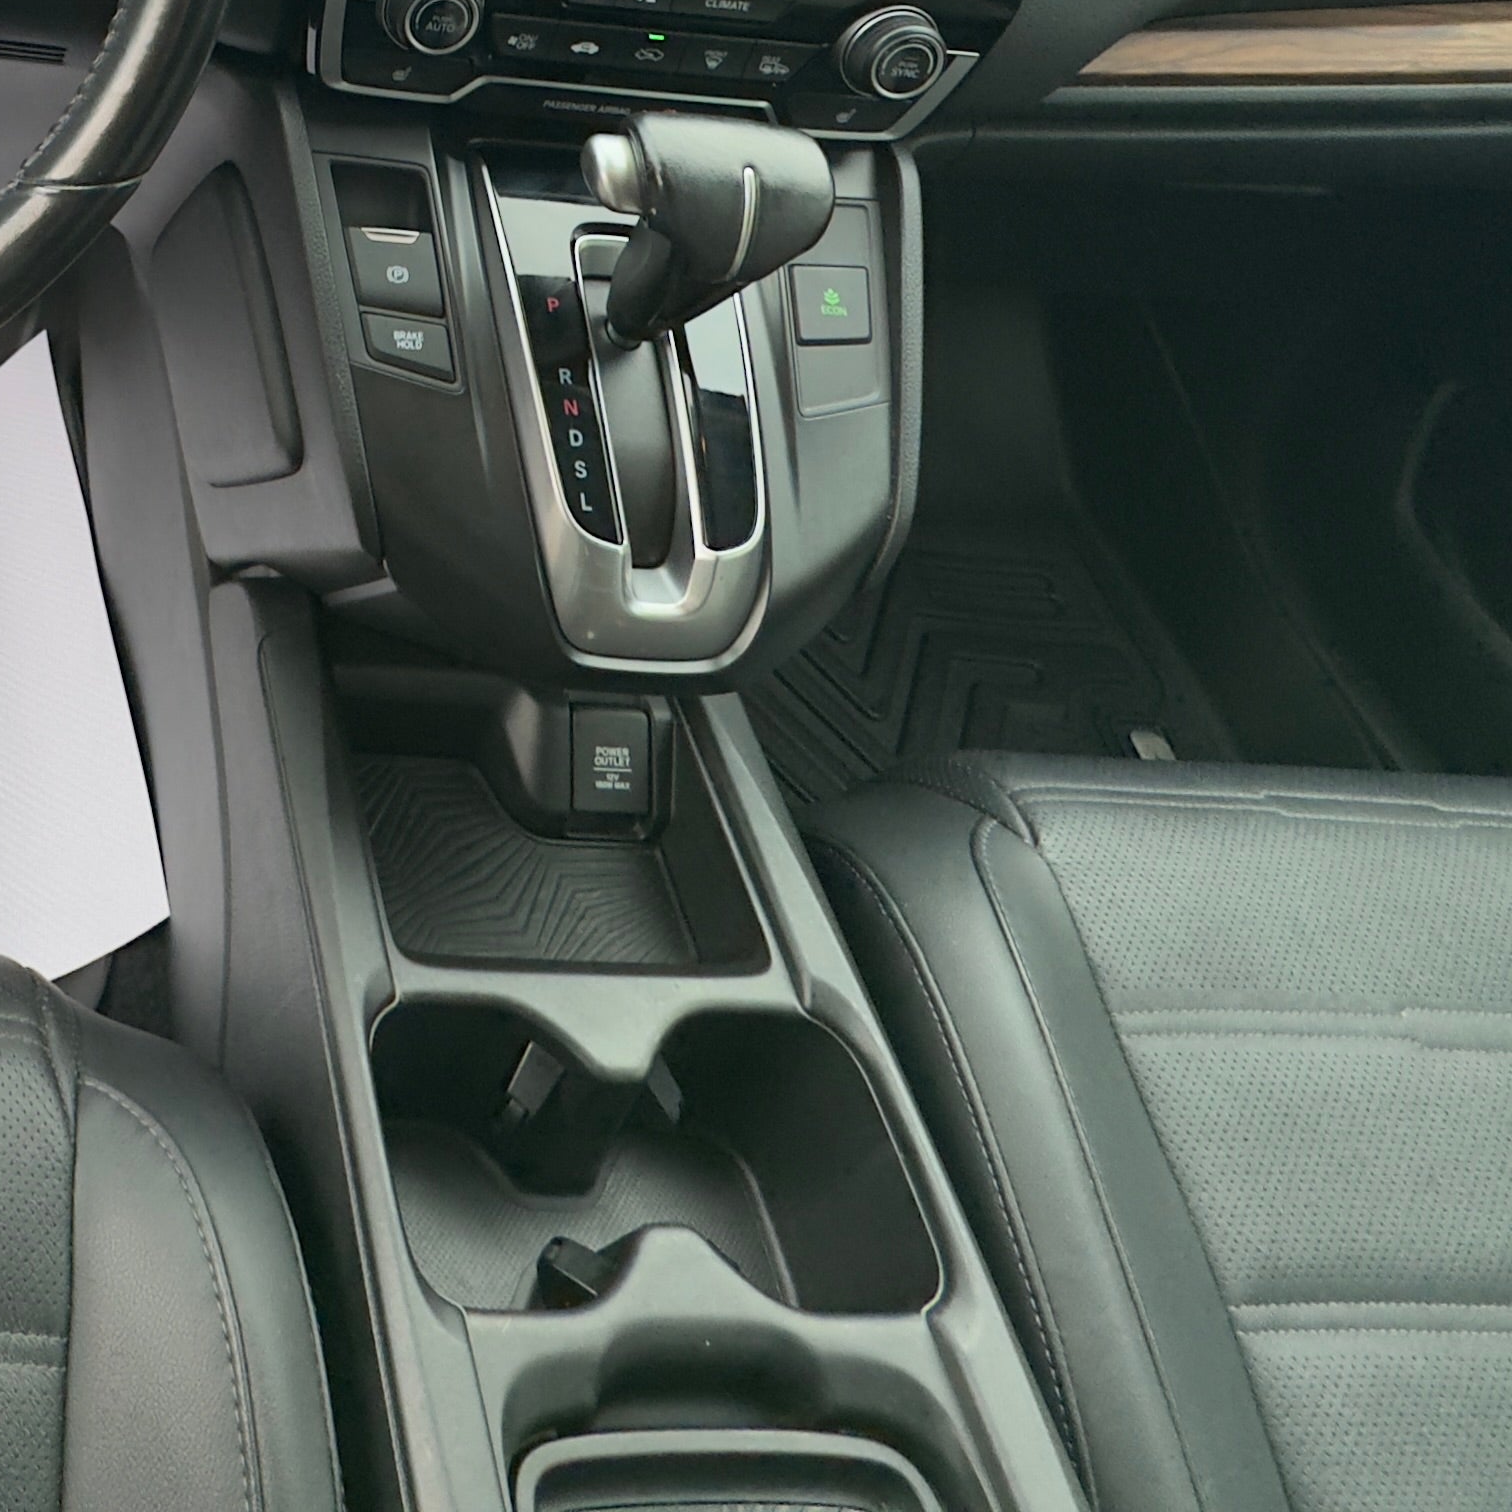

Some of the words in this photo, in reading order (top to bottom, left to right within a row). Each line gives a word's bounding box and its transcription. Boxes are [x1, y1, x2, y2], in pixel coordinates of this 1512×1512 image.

[425, 21, 456, 33] AUTO
[515, 40, 536, 51] OFF
[890, 67, 921, 80] SYNC
[543, 99, 597, 113] PASSENGER
[547, 297, 560, 313] P
[821, 304, 847, 316] ECON
[393, 330, 424, 342] BRAKE
[396, 339, 423, 351] HOLD
[558, 368, 573, 385] R
[563, 399, 579, 416] N
[569, 429, 584, 447] D
[574, 460, 588, 479] S
[580, 492, 593, 511] L
[596, 746, 629, 756] POWER
[594, 757, 630, 766] OUTLET
